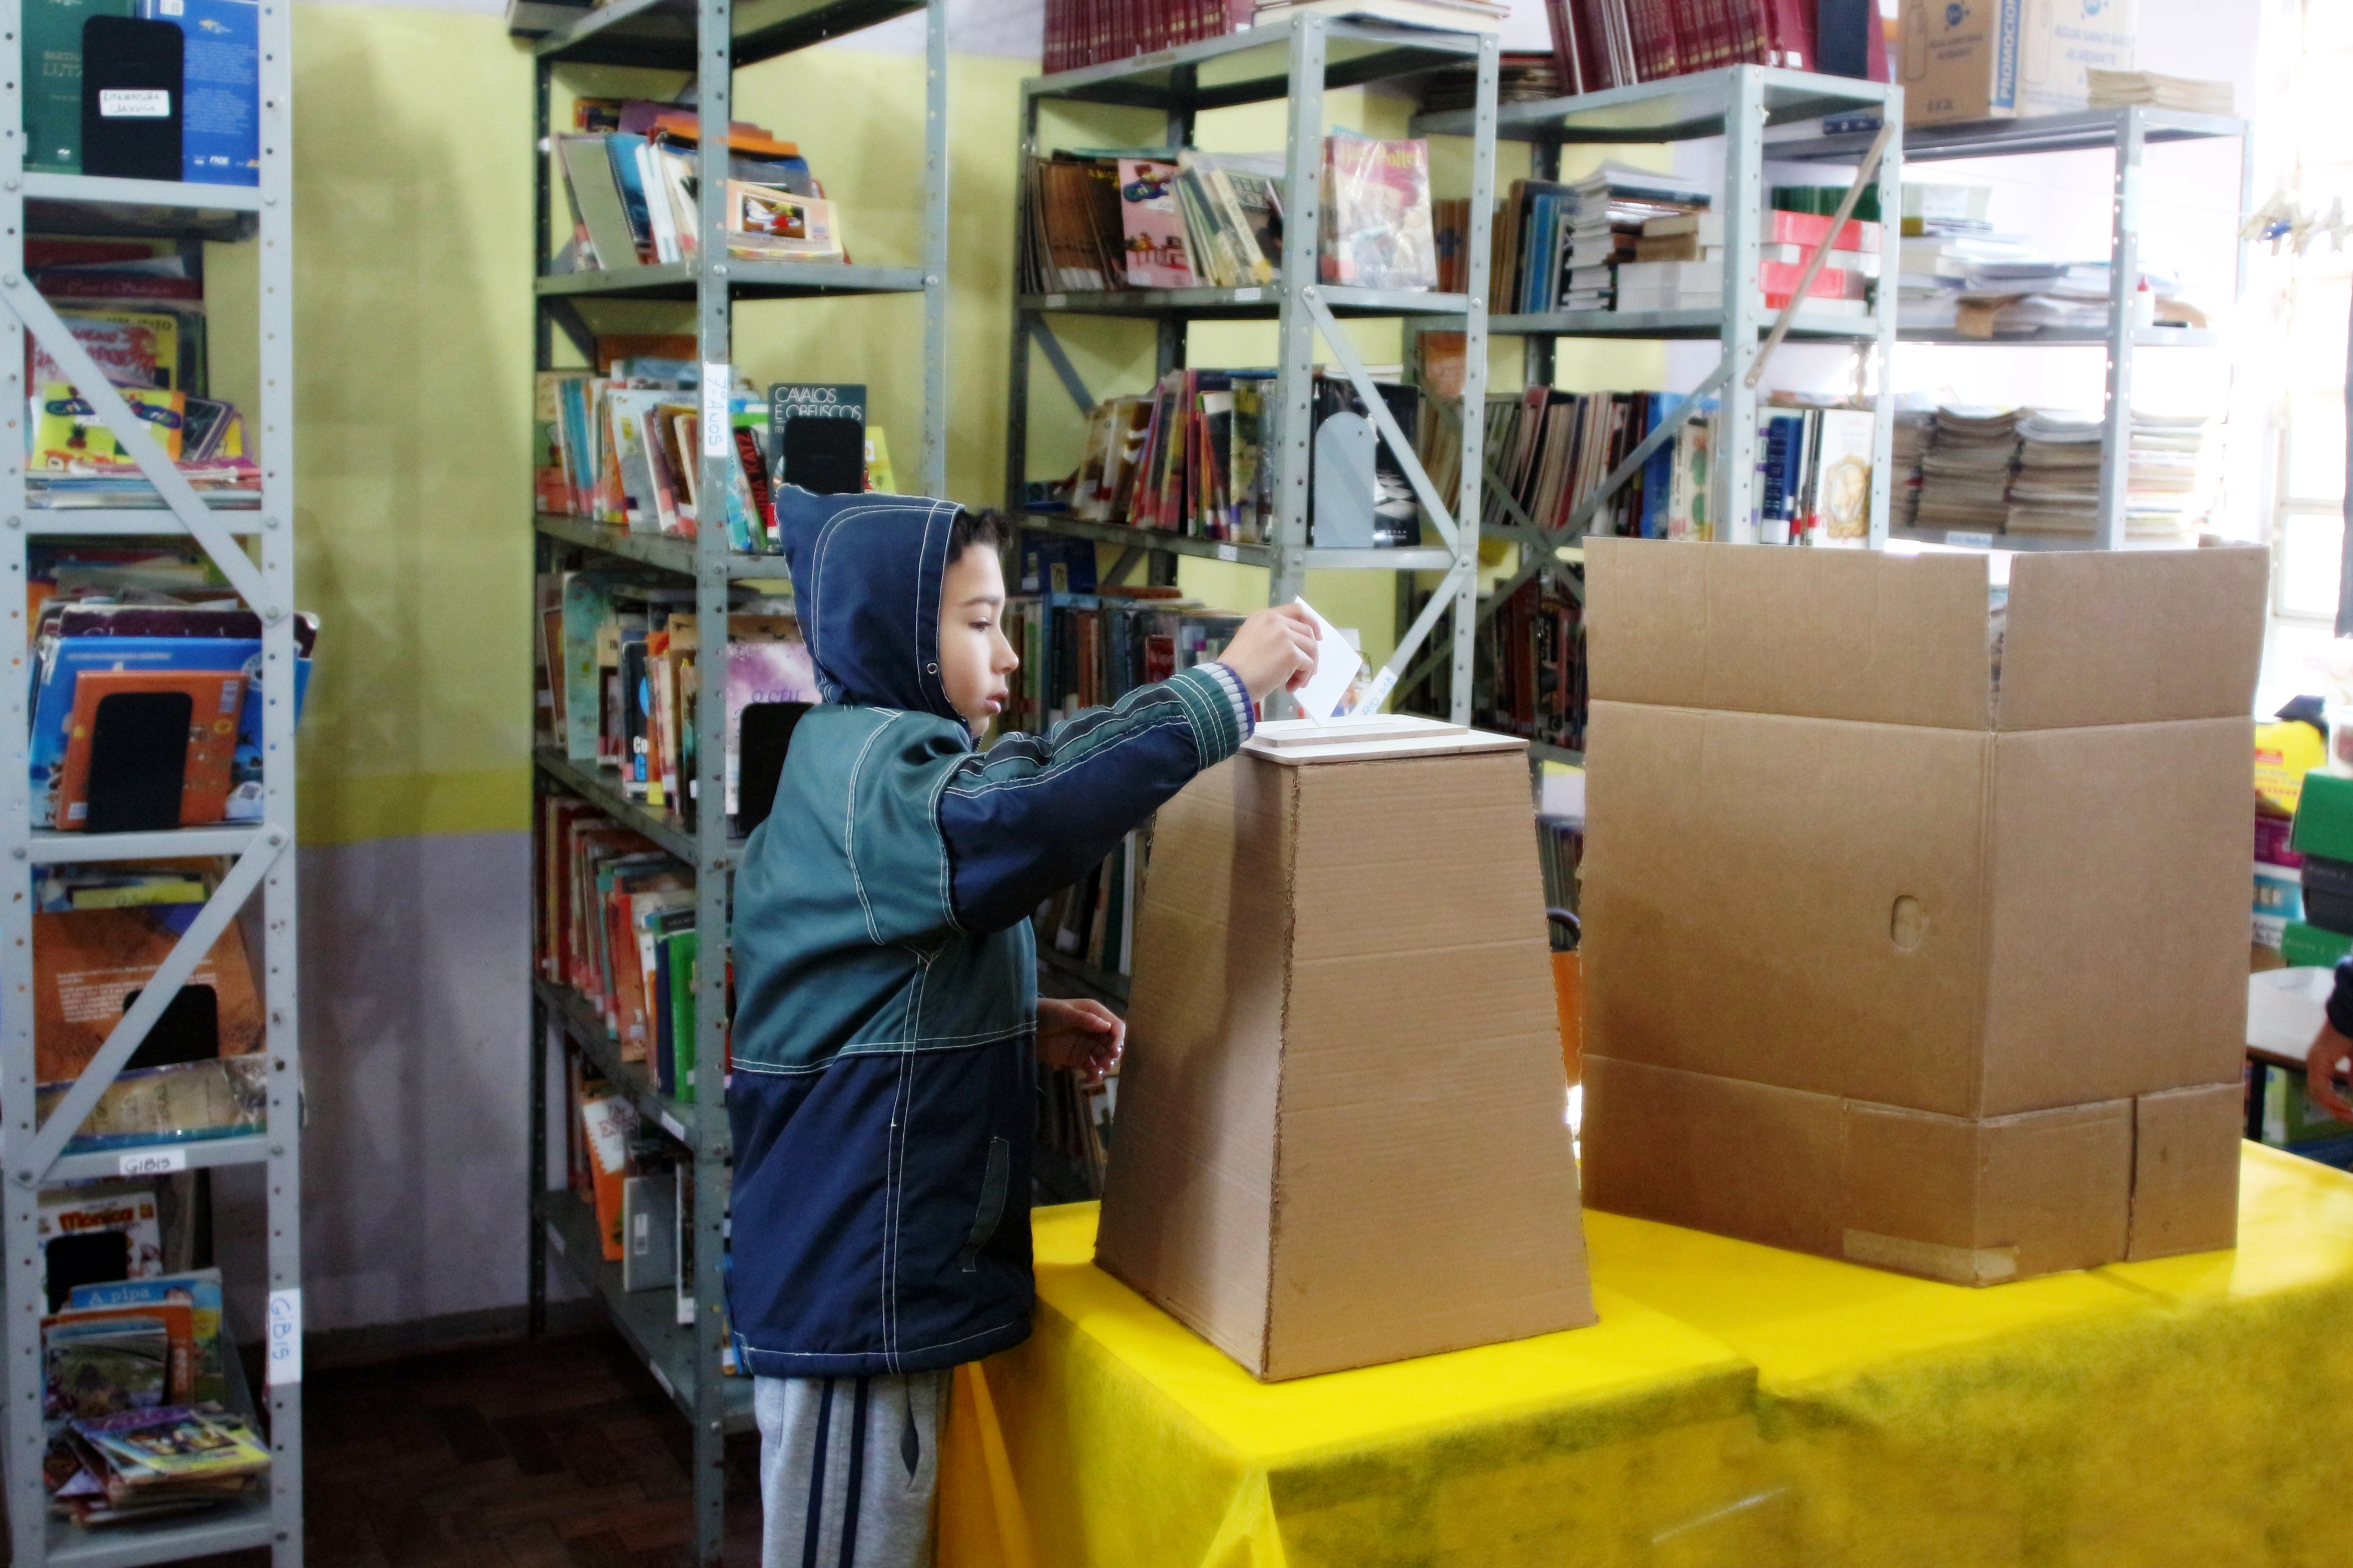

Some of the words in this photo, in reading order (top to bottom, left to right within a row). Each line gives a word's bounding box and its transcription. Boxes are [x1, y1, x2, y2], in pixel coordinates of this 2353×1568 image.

[775, 386, 836, 403] CAVALOS
[775, 404, 783, 420] E
[110, 1287, 151, 1303] pipa
